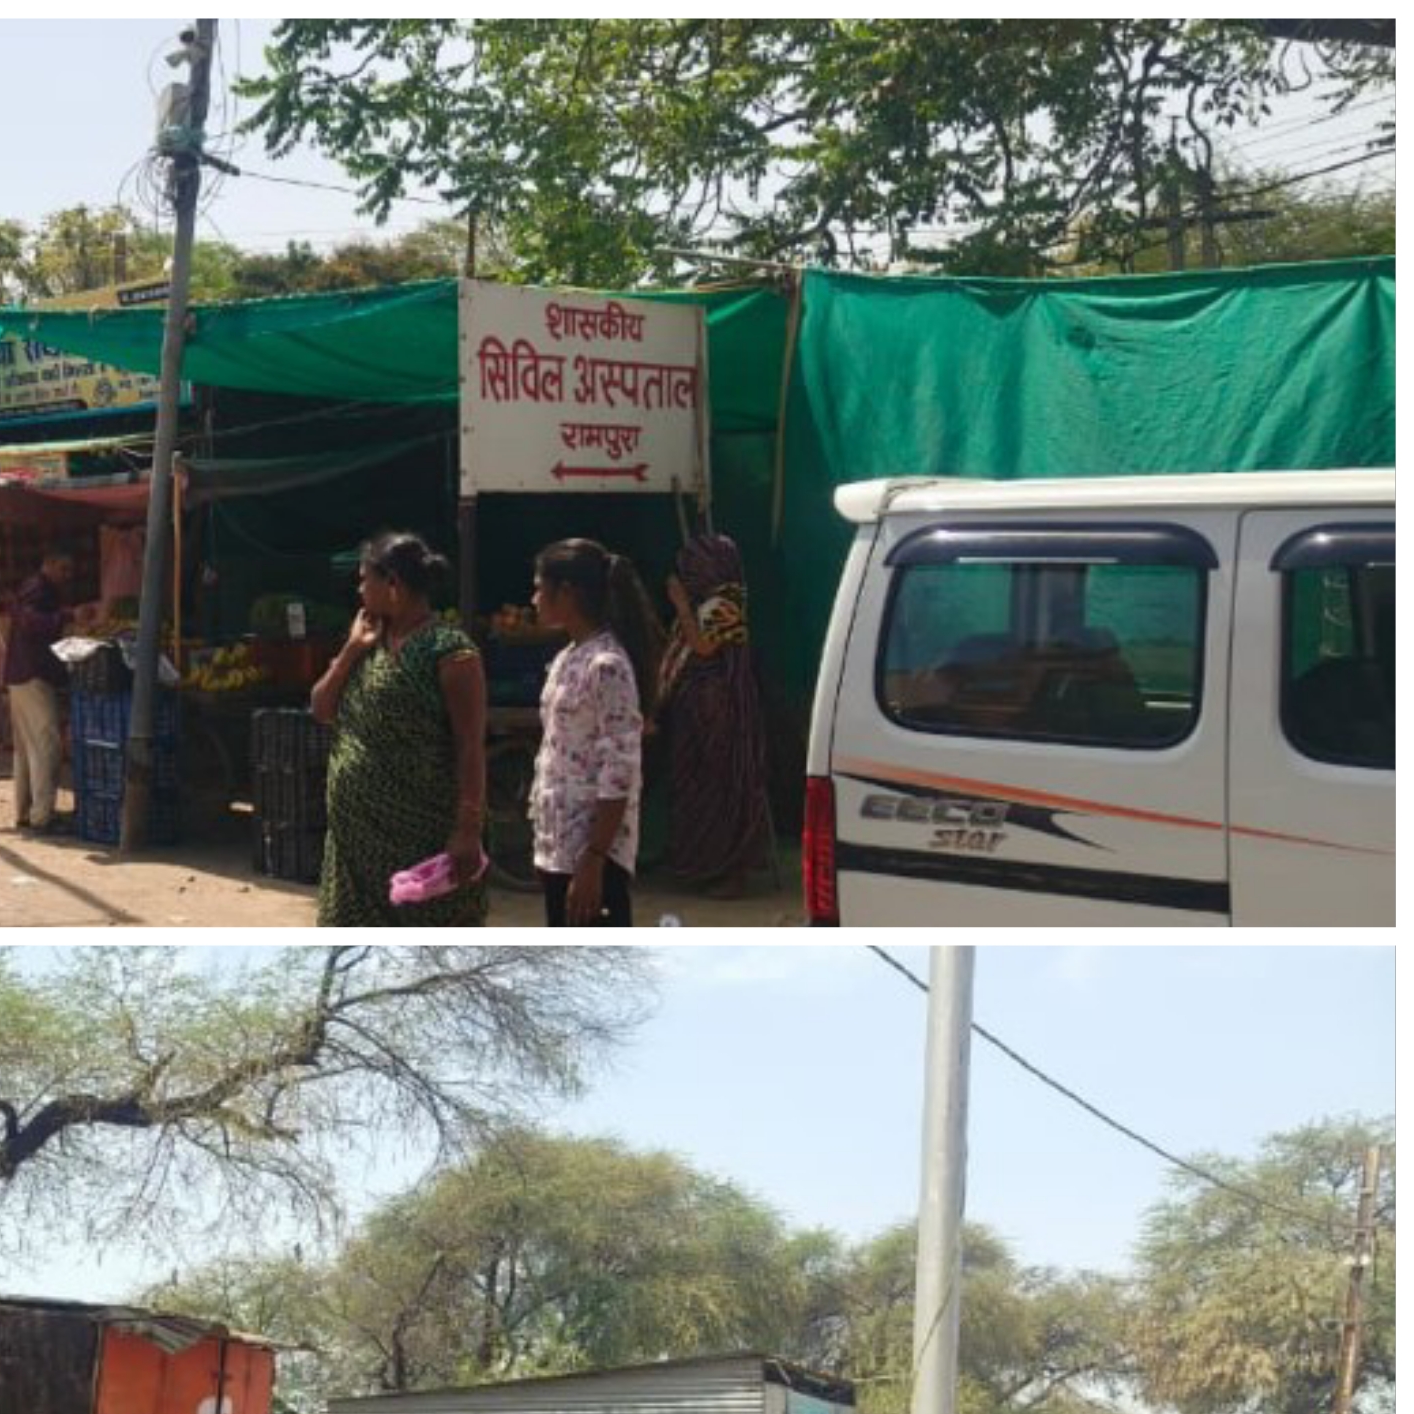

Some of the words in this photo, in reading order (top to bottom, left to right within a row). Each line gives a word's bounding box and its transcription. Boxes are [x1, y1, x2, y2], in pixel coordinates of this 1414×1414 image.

[546, 302, 645, 342] शासकीय
[477, 336, 566, 402] सिविल
[573, 354, 698, 410] अस्पताल
[559, 422, 642, 460] रामपुरा
